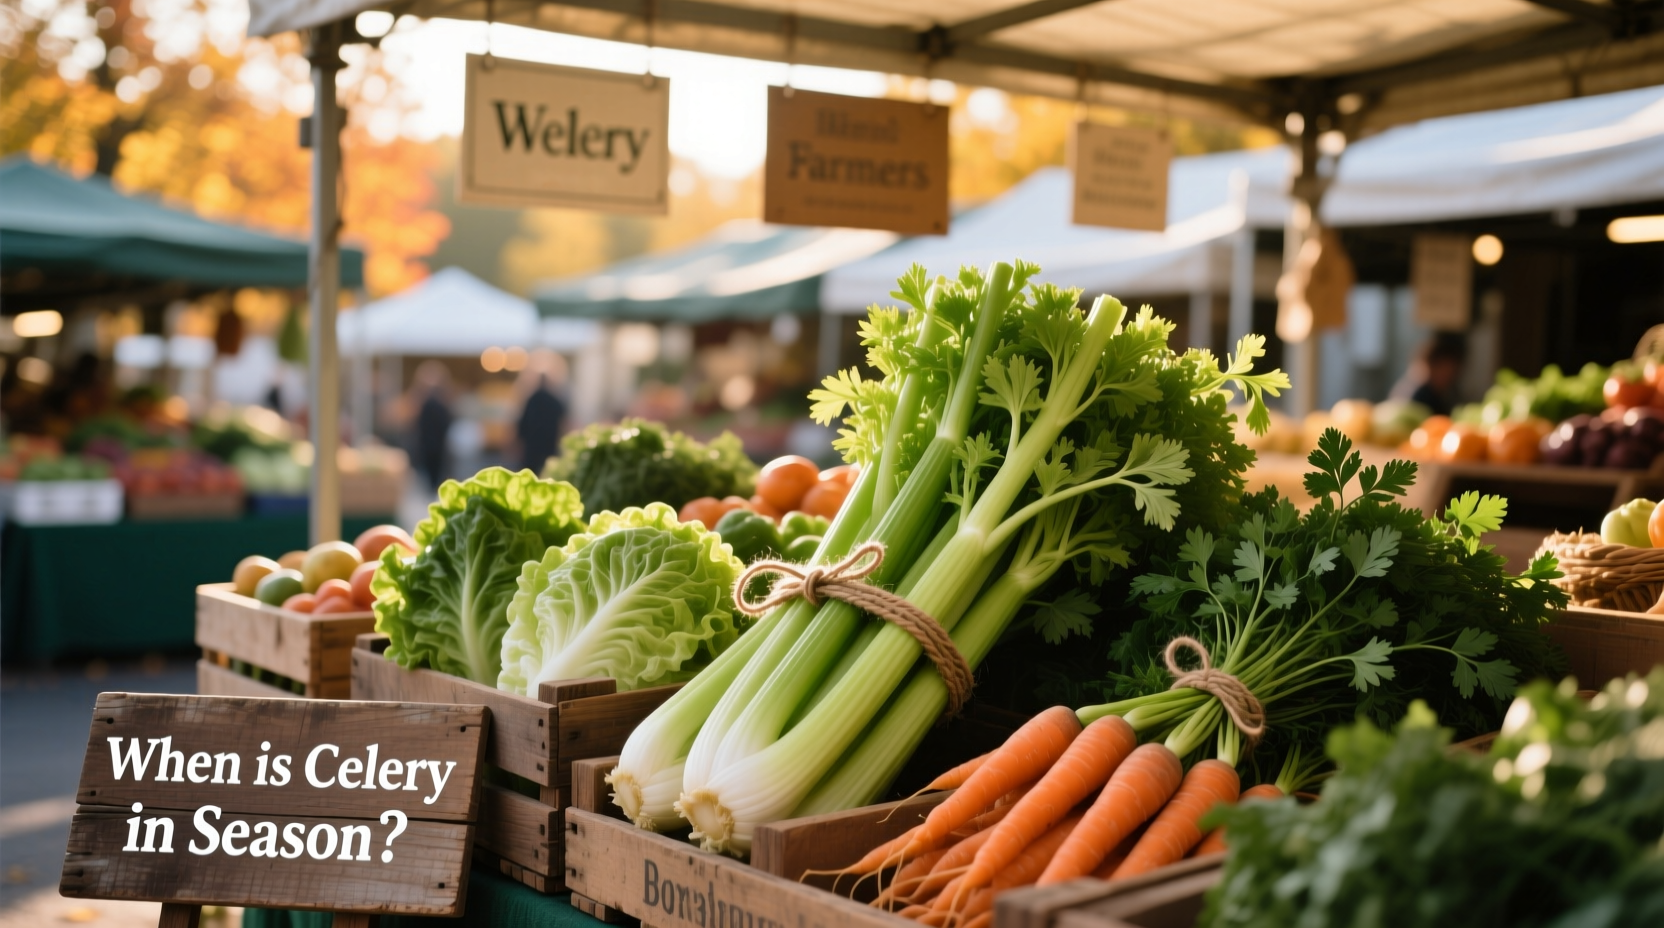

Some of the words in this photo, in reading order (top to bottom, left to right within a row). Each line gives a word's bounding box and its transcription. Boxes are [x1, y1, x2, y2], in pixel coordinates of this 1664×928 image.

[491, 98, 651, 174] Welery
[786, 139, 931, 191] Farmers
[106, 735, 241, 786] When
[252, 740, 292, 787] is
[304, 743, 458, 805] Celery
[121, 801, 175, 853] in
[188, 804, 408, 864] Season?
